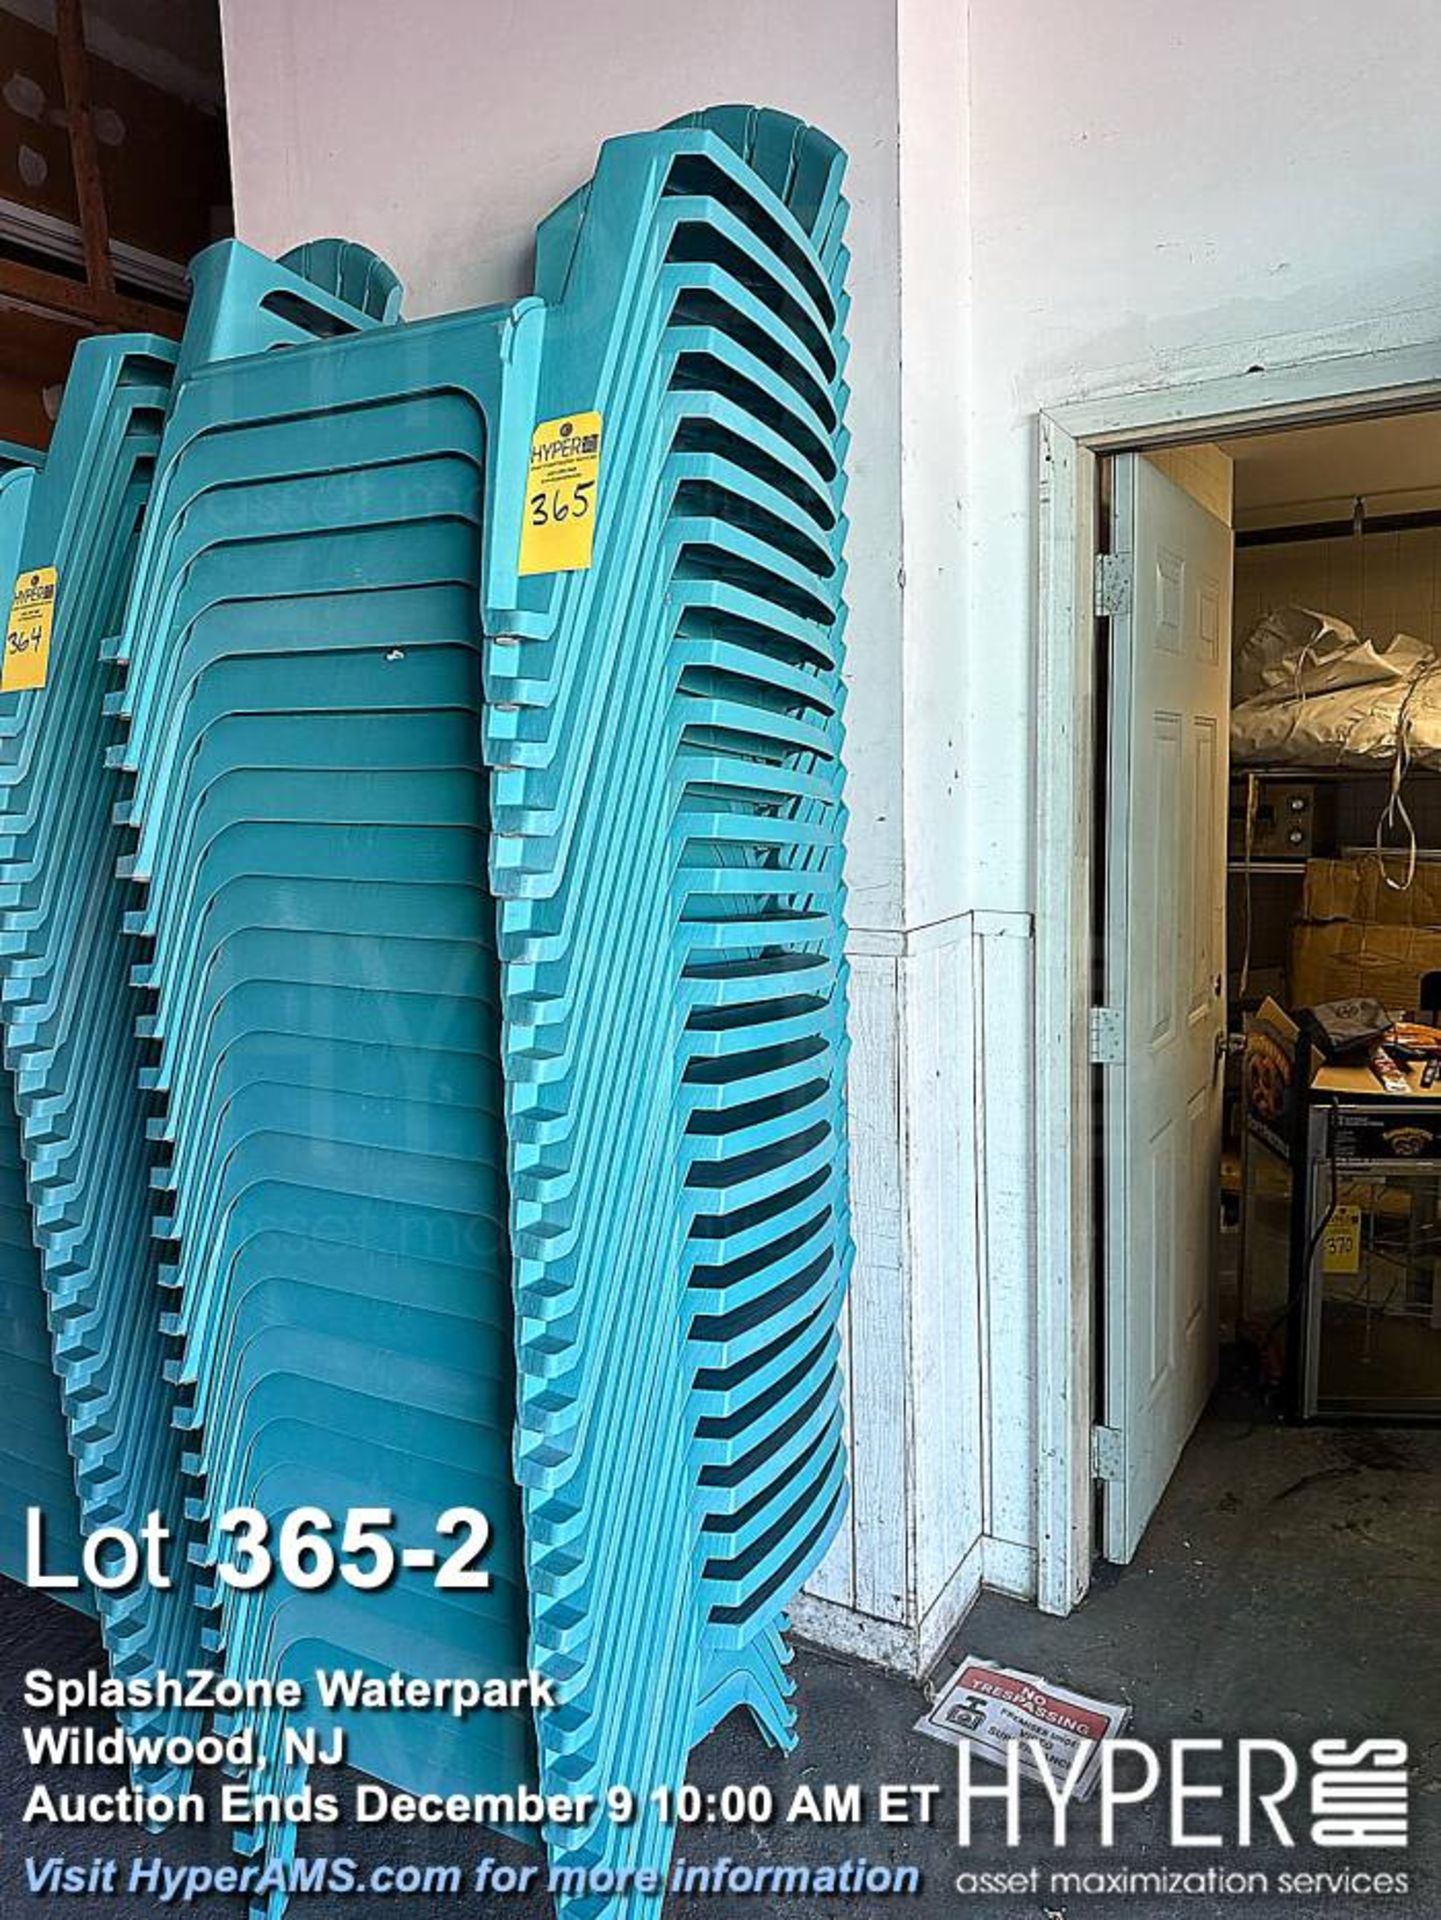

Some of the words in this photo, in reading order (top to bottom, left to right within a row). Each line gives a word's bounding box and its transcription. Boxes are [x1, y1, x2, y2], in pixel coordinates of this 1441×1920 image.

[531, 436, 582, 464] HYPER
[530, 480, 595, 526] 365
[8, 625, 42, 655] 364
[970, 1678, 1091, 1736] TRESPASSING
[1020, 1686, 1047, 1707] NO
